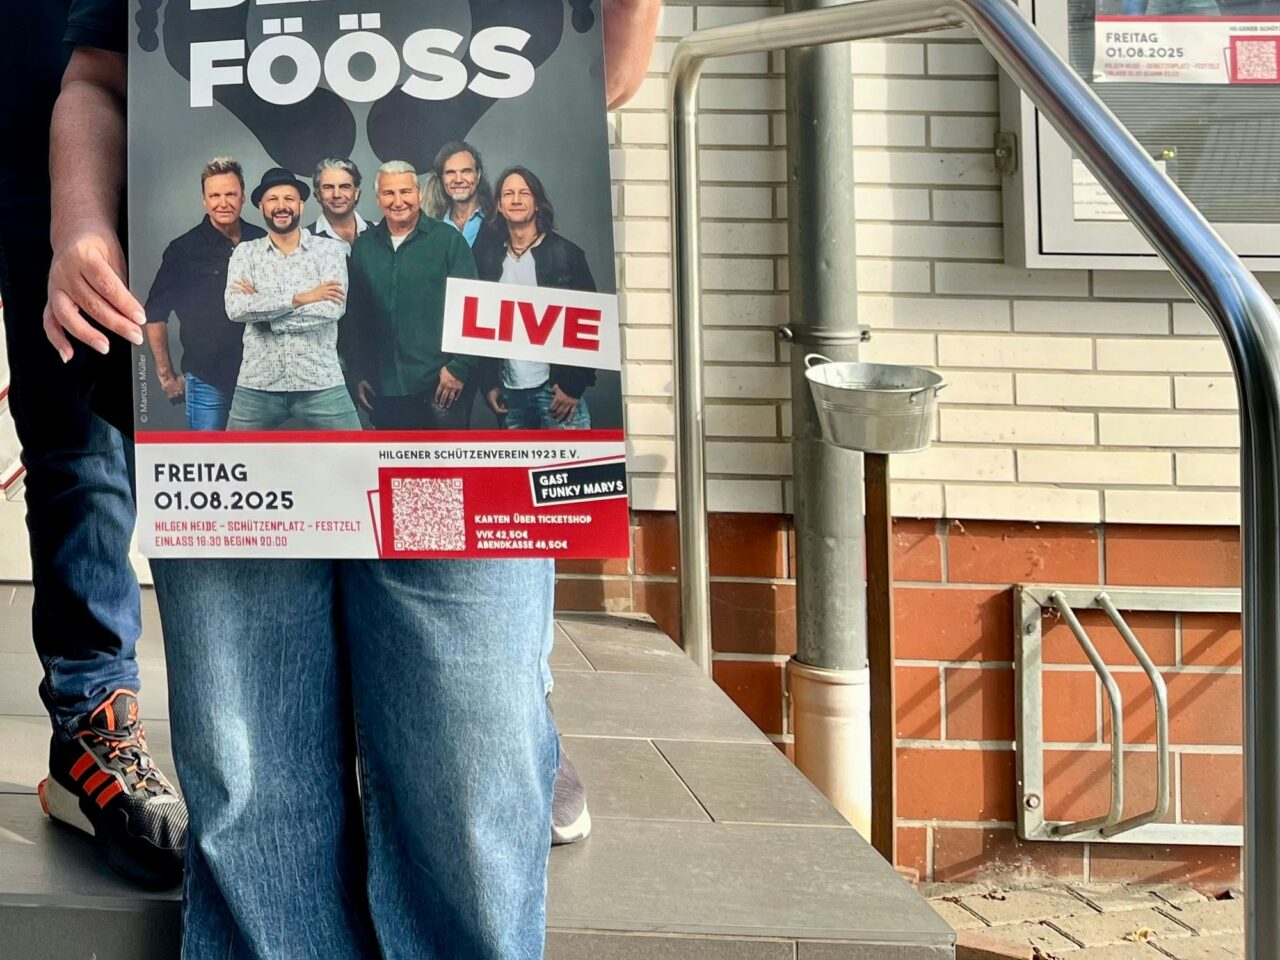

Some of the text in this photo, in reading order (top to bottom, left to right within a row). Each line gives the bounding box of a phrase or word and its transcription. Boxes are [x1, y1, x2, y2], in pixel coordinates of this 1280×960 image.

[1106, 33, 1158, 43] FREITAG
[1106, 47, 1183, 58] 01.08.2025
[189, 12, 536, 108] FÖÖSS
[462, 296, 602, 352] LIVE
[138, 354, 147, 380] Müller
[140, 382, 148, 413] Marcus
[379, 448, 580, 459] HILGENER SCHÜTZENVEREIN 1923 E.V.
[154, 463, 248, 482] FREITAG
[539, 473, 568, 486] GAST
[542, 485, 581, 499] FUNKY
[154, 491, 294, 510] 01.08.2025
[474, 512, 592, 524] KARTEN ÜBER TICKETSHOP
[155, 521, 187, 532] HILGEN
[190, 521, 217, 531] HEIDE
[228, 520, 305, 531] SCHÜTZENPLATZ
[315, 521, 361, 531] FESTZELT
[476, 530, 494, 539] VVK
[155, 536, 194, 547] EINLASS
[224, 536, 258, 546] BEGINN
[260, 536, 287, 546] 20:00
[477, 541, 533, 549] ABENDKASSE
